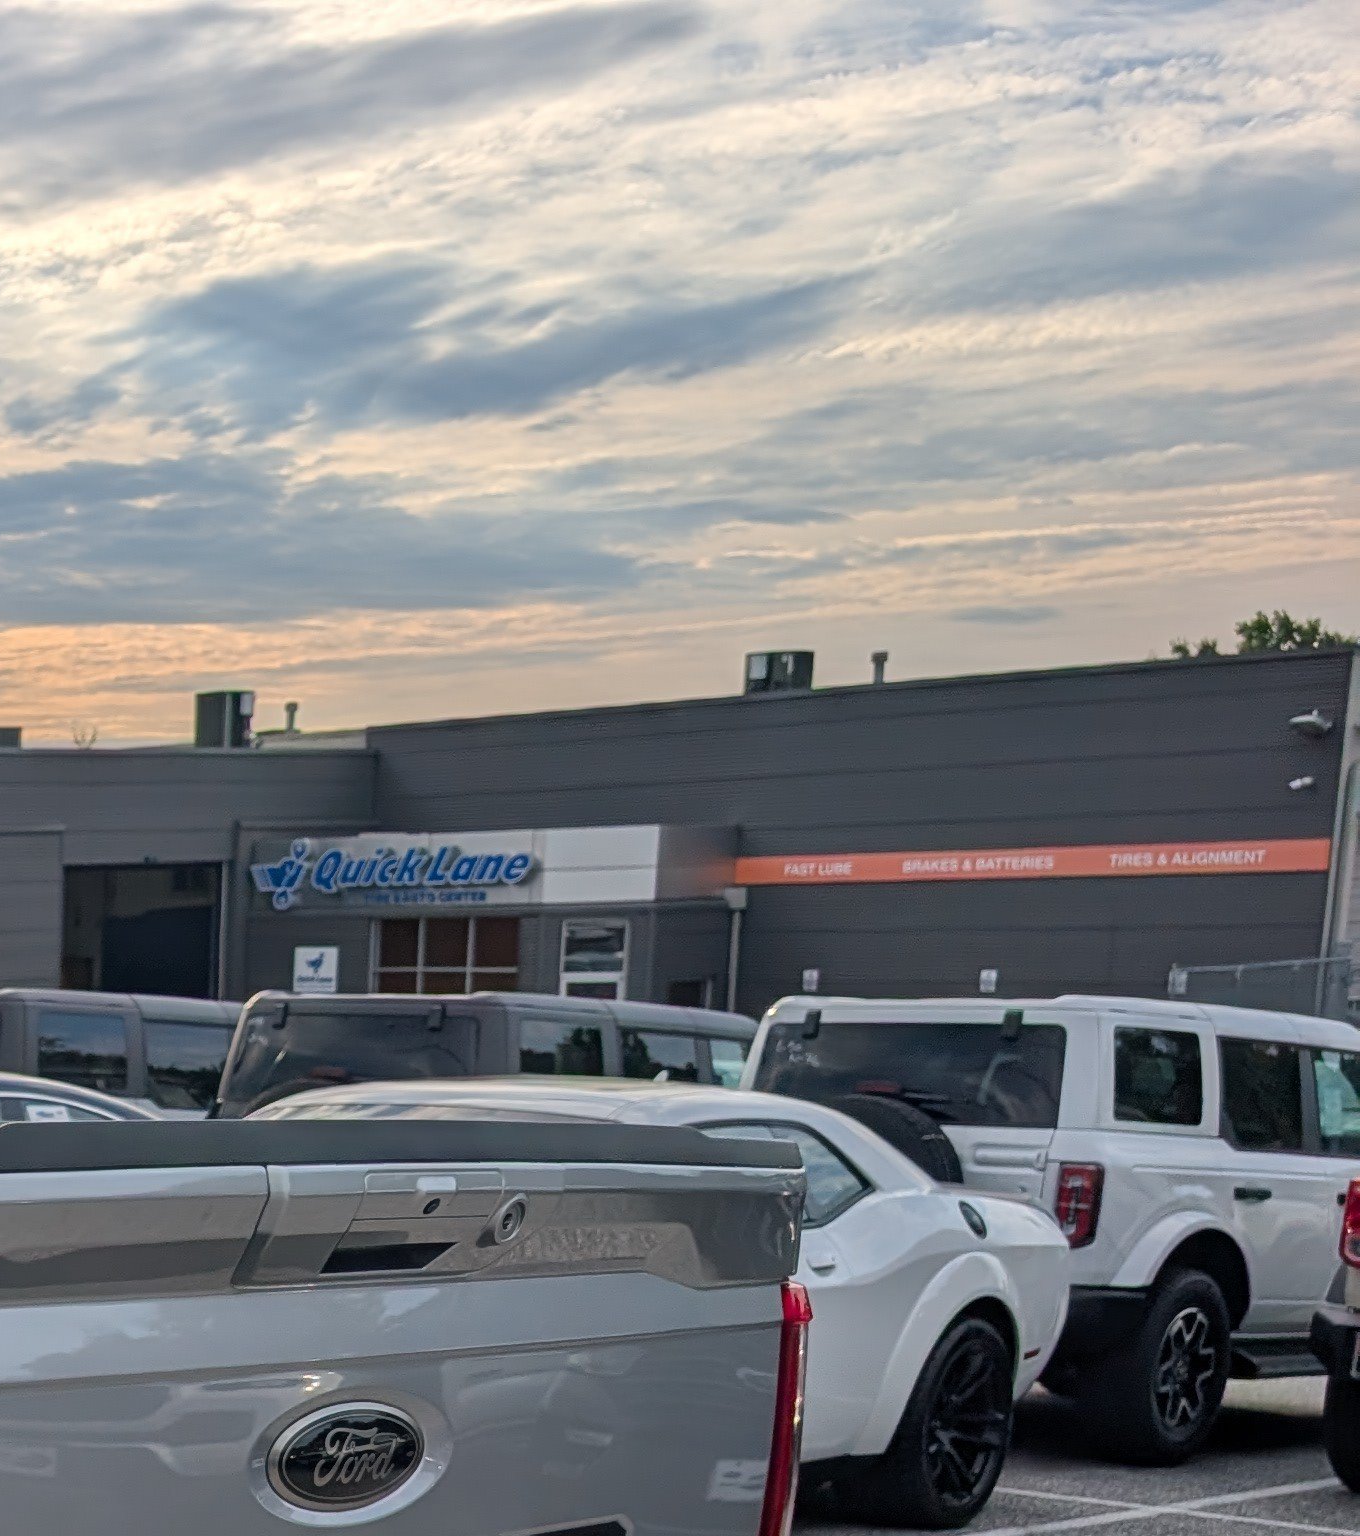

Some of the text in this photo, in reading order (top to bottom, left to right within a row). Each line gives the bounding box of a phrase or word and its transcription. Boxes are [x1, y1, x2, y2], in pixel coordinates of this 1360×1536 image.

[902, 858, 958, 873] BRAKES
[975, 855, 1054, 871] BATTERIES
[1109, 850, 1266, 868] TIRES & ALIGNMENT
[312, 845, 532, 893] Quick Lane
[784, 862, 814, 876] FAST
[314, 1426, 400, 1488] Ford
